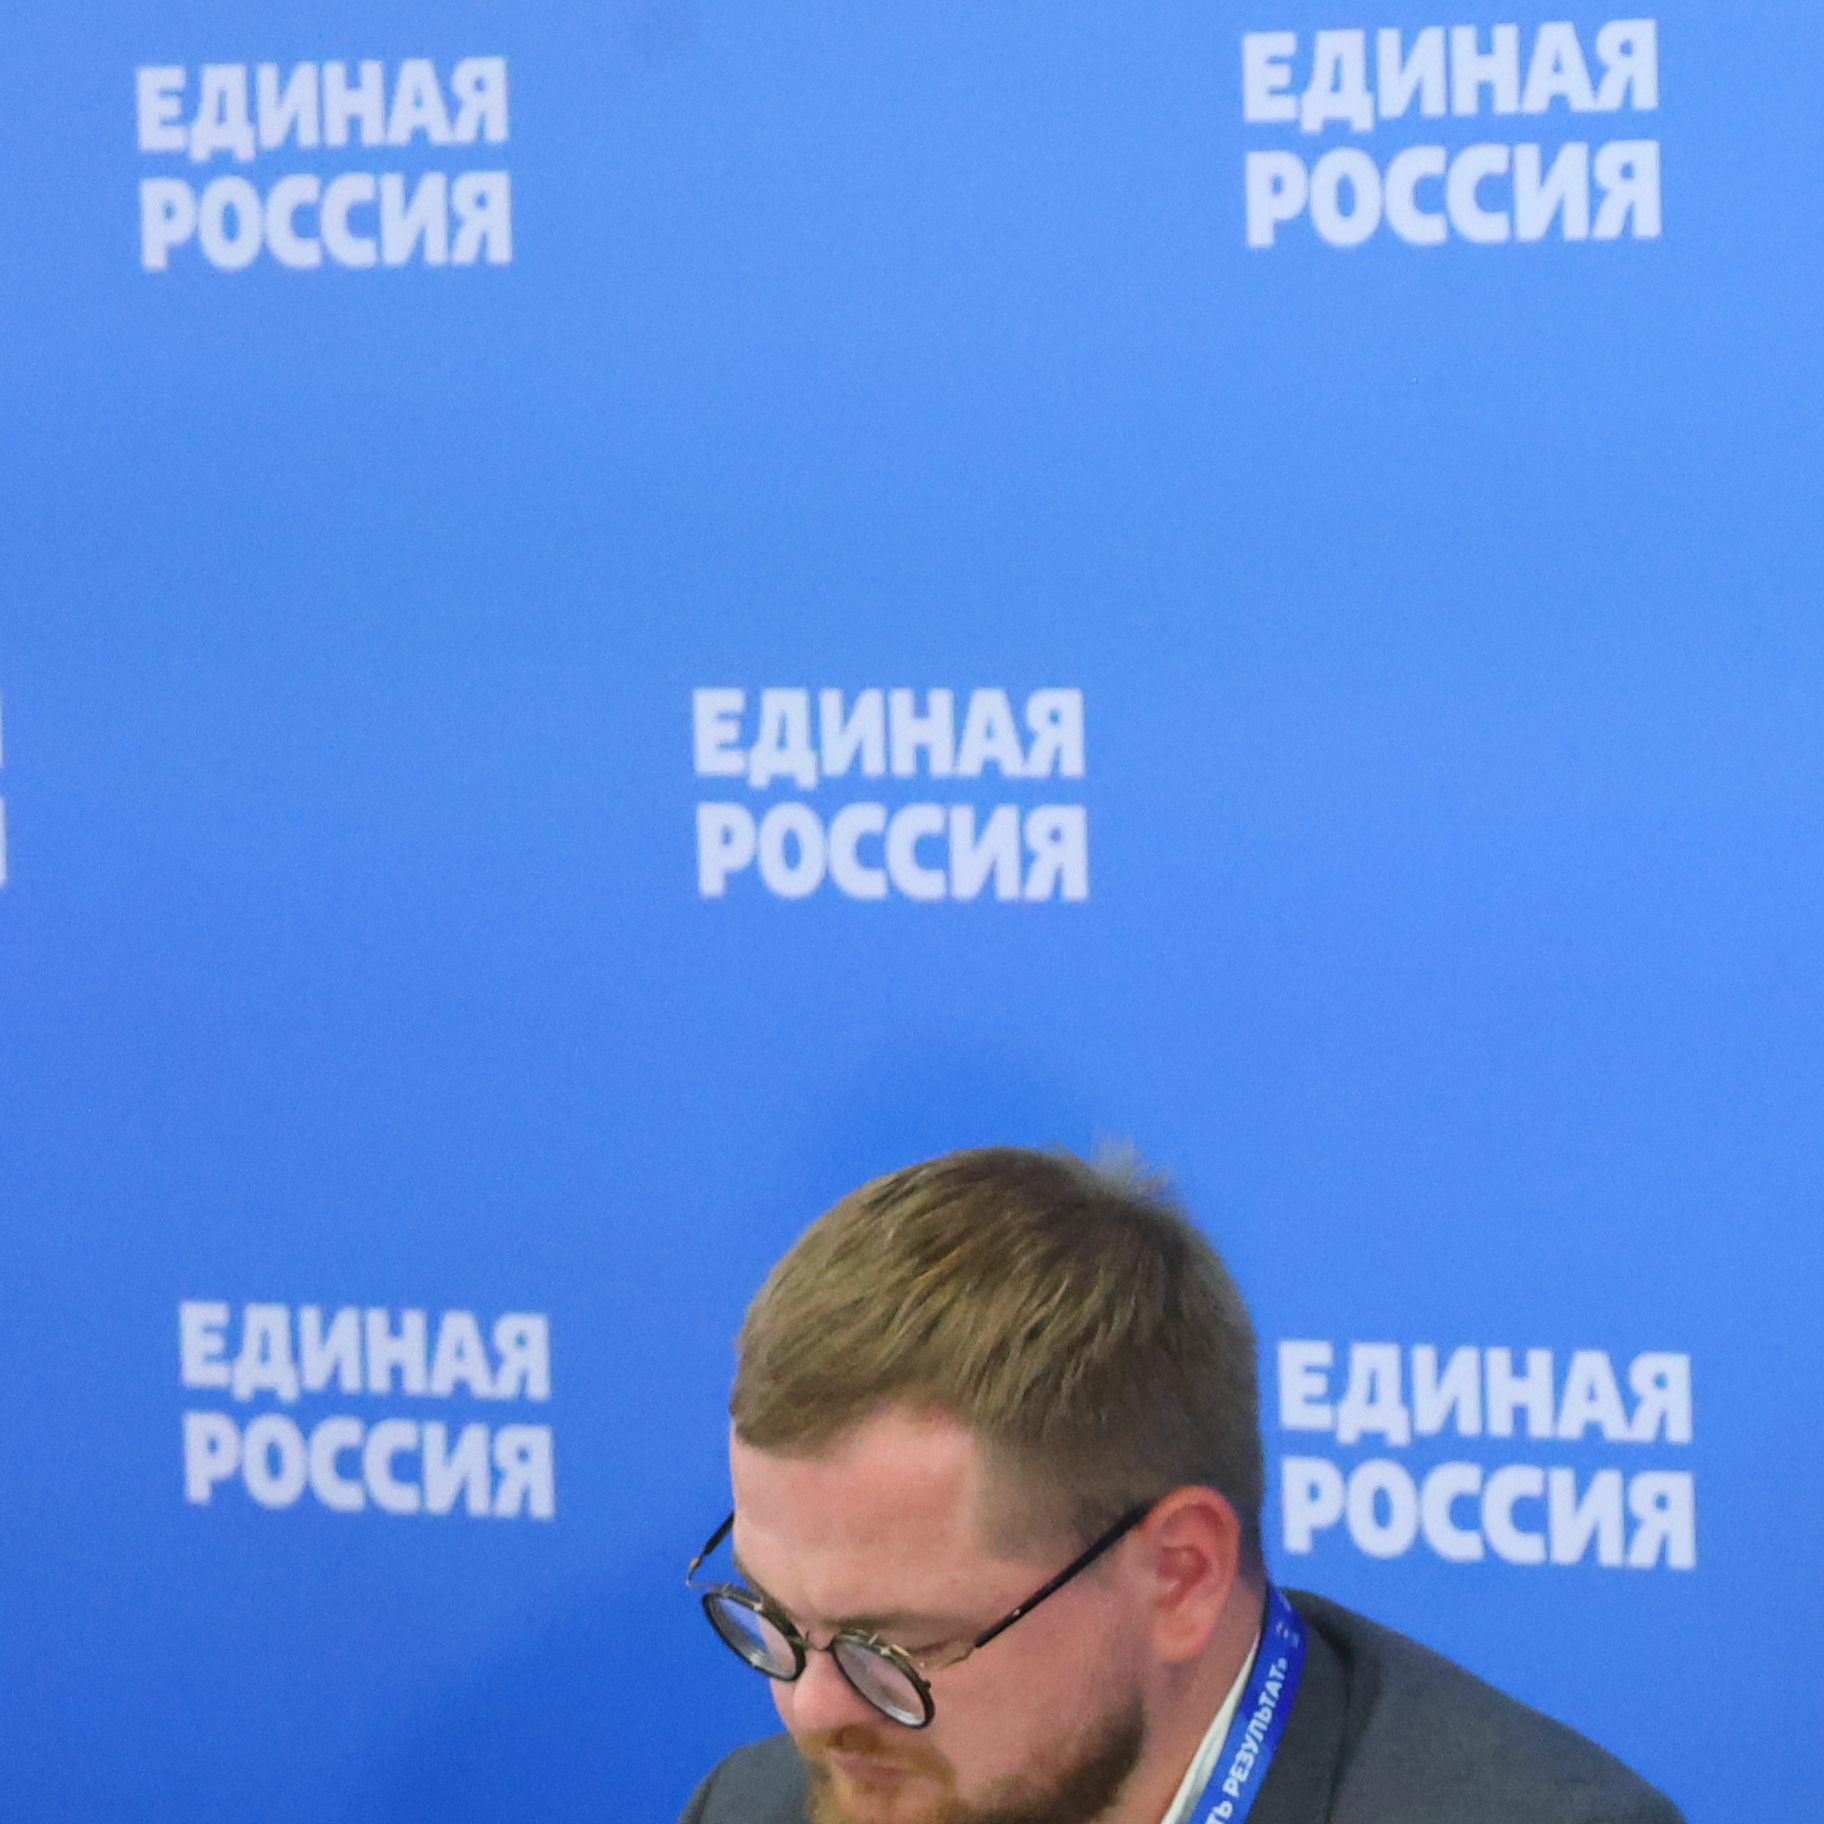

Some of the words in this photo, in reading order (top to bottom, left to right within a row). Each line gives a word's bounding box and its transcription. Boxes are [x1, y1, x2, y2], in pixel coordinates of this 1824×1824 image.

[134, 54, 511, 165] ЕДИНАЯ
[1240, 17, 1661, 136] ЕДИНАЯ
[137, 169, 514, 273] РОССИЯ
[1243, 138, 1664, 251] РОССИЯ
[692, 686, 1087, 791] ЕДИНАЯ
[694, 800, 1091, 904] РОССИЯ
[179, 1300, 552, 1402] ЕДИНАЯ
[1277, 1338, 1694, 1447] ЕДИНАЯ
[183, 1411, 556, 1519] РОССИЯ
[1280, 1454, 1698, 1570] РОССИЯ
